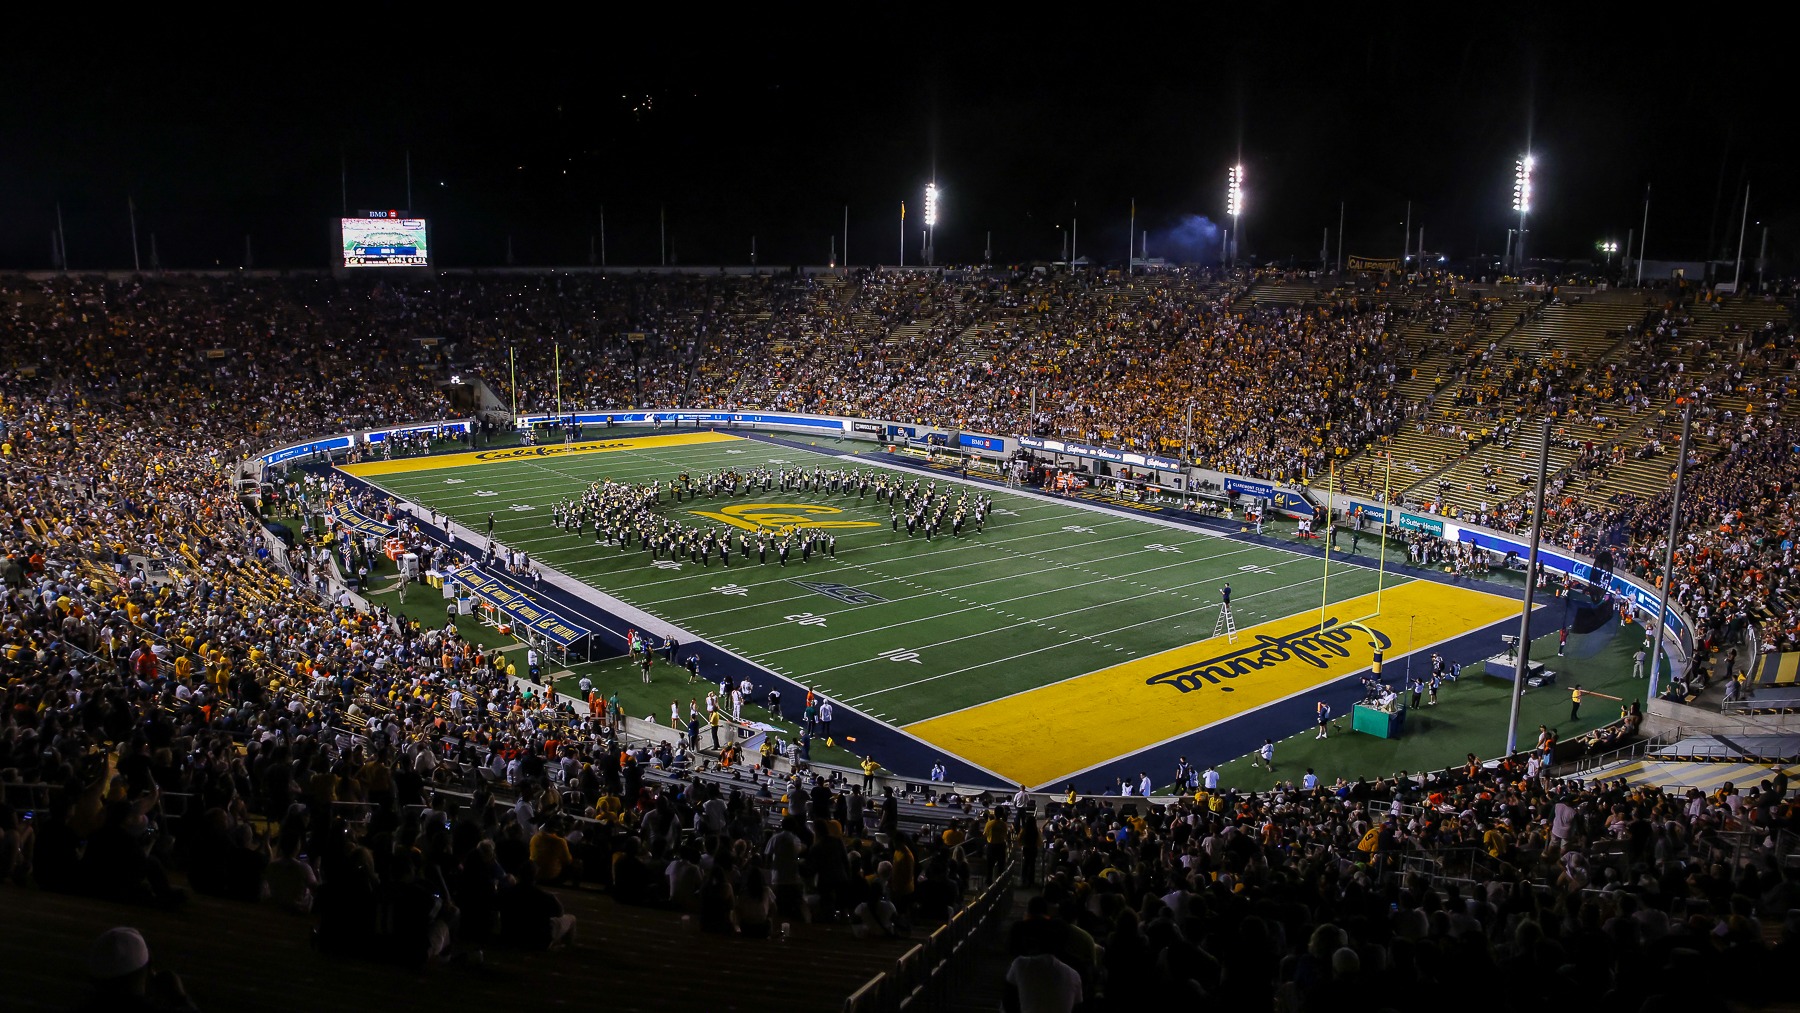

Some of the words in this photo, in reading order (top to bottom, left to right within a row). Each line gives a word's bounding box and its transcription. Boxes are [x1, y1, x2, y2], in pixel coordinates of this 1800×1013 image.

[1349, 259, 1397, 271] CALIFORNIA
[971, 438, 984, 446] BMO
[475, 443, 634, 462] California
[1232, 482, 1256, 491] CLAREMONT
[783, 612, 828, 628] 20
[877, 648, 923, 665] 10
[1146, 616, 1392, 694] California
